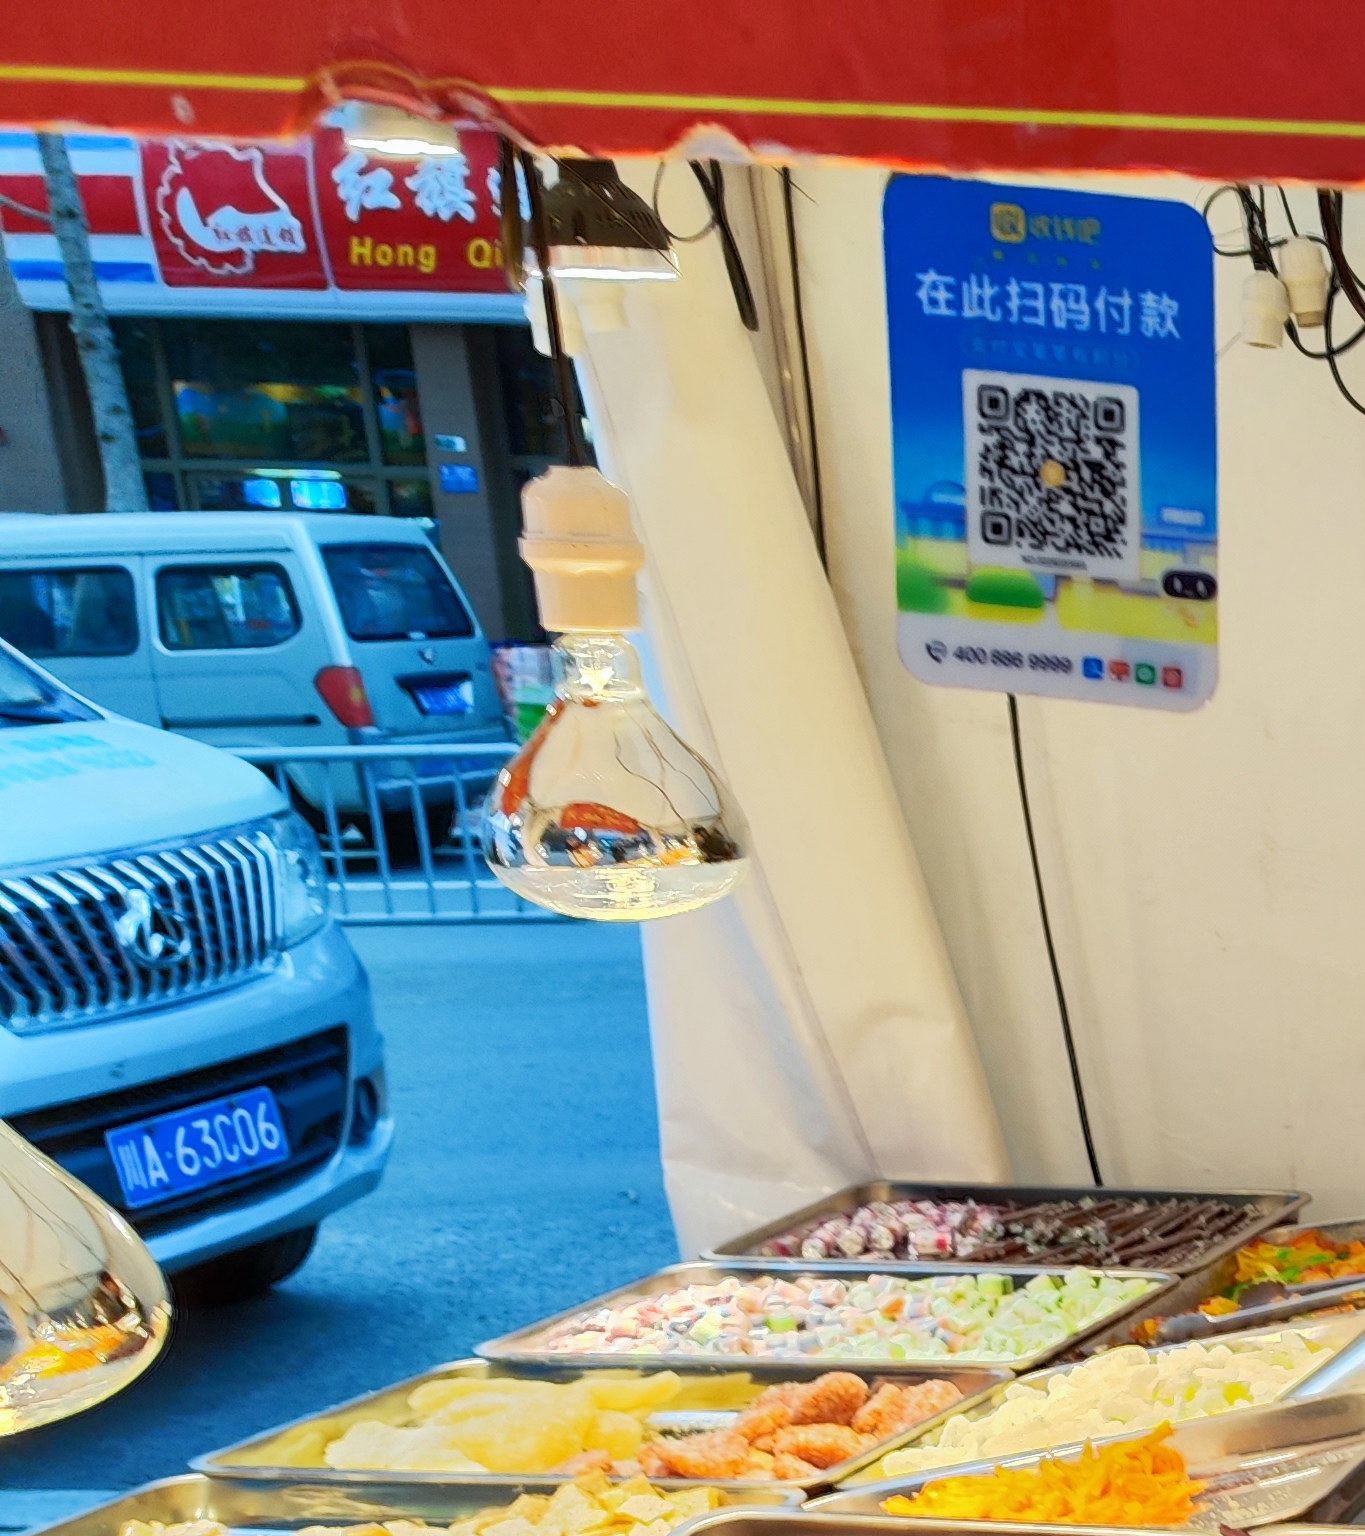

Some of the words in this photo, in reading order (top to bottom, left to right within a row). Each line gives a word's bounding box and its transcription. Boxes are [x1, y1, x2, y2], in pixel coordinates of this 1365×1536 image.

[349, 236, 437, 274] Hong
[915, 268, 1183, 340] 在此扫码付款
[953, 645, 987, 665] 400
